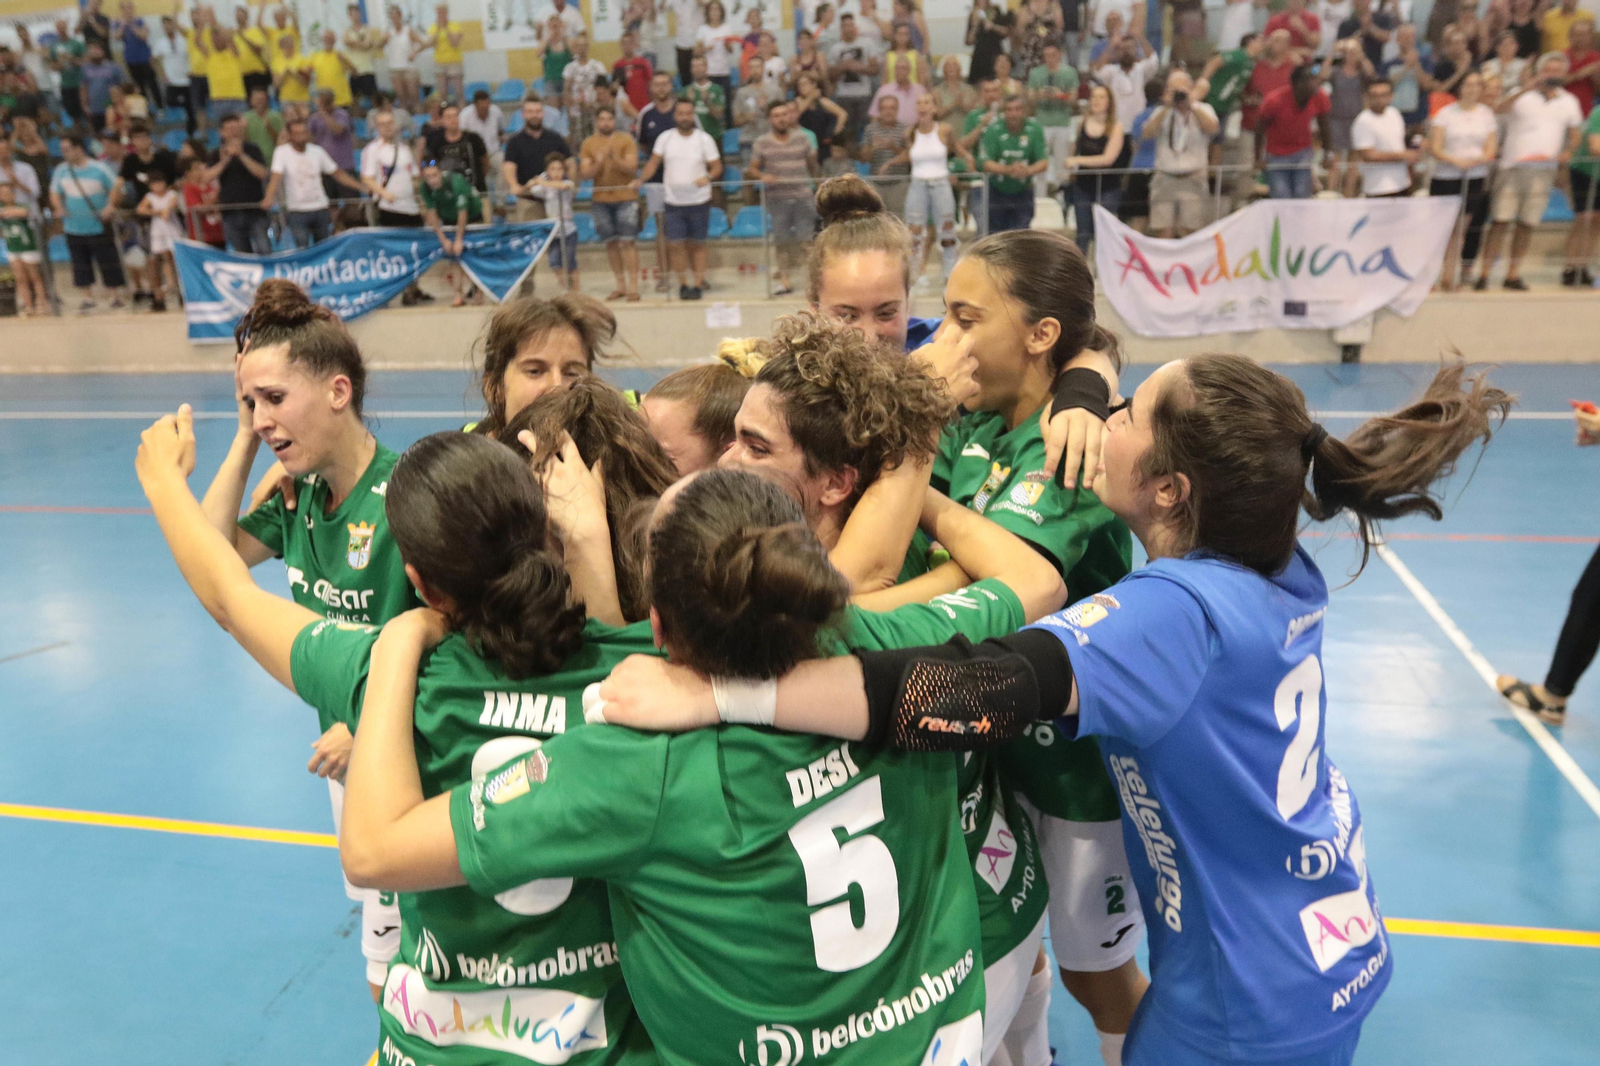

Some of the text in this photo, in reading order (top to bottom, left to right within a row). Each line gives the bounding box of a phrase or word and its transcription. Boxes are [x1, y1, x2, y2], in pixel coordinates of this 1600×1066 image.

[274, 249, 408, 294] Diputación
[1114, 214, 1415, 299] Andalucía
[479, 691, 566, 734] INMA
[1274, 653, 1322, 822] 2
[785, 742, 860, 808] DESI
[787, 774, 900, 973] 5
[1106, 884, 1126, 915] 2
[811, 948, 974, 1059] belcónobras
